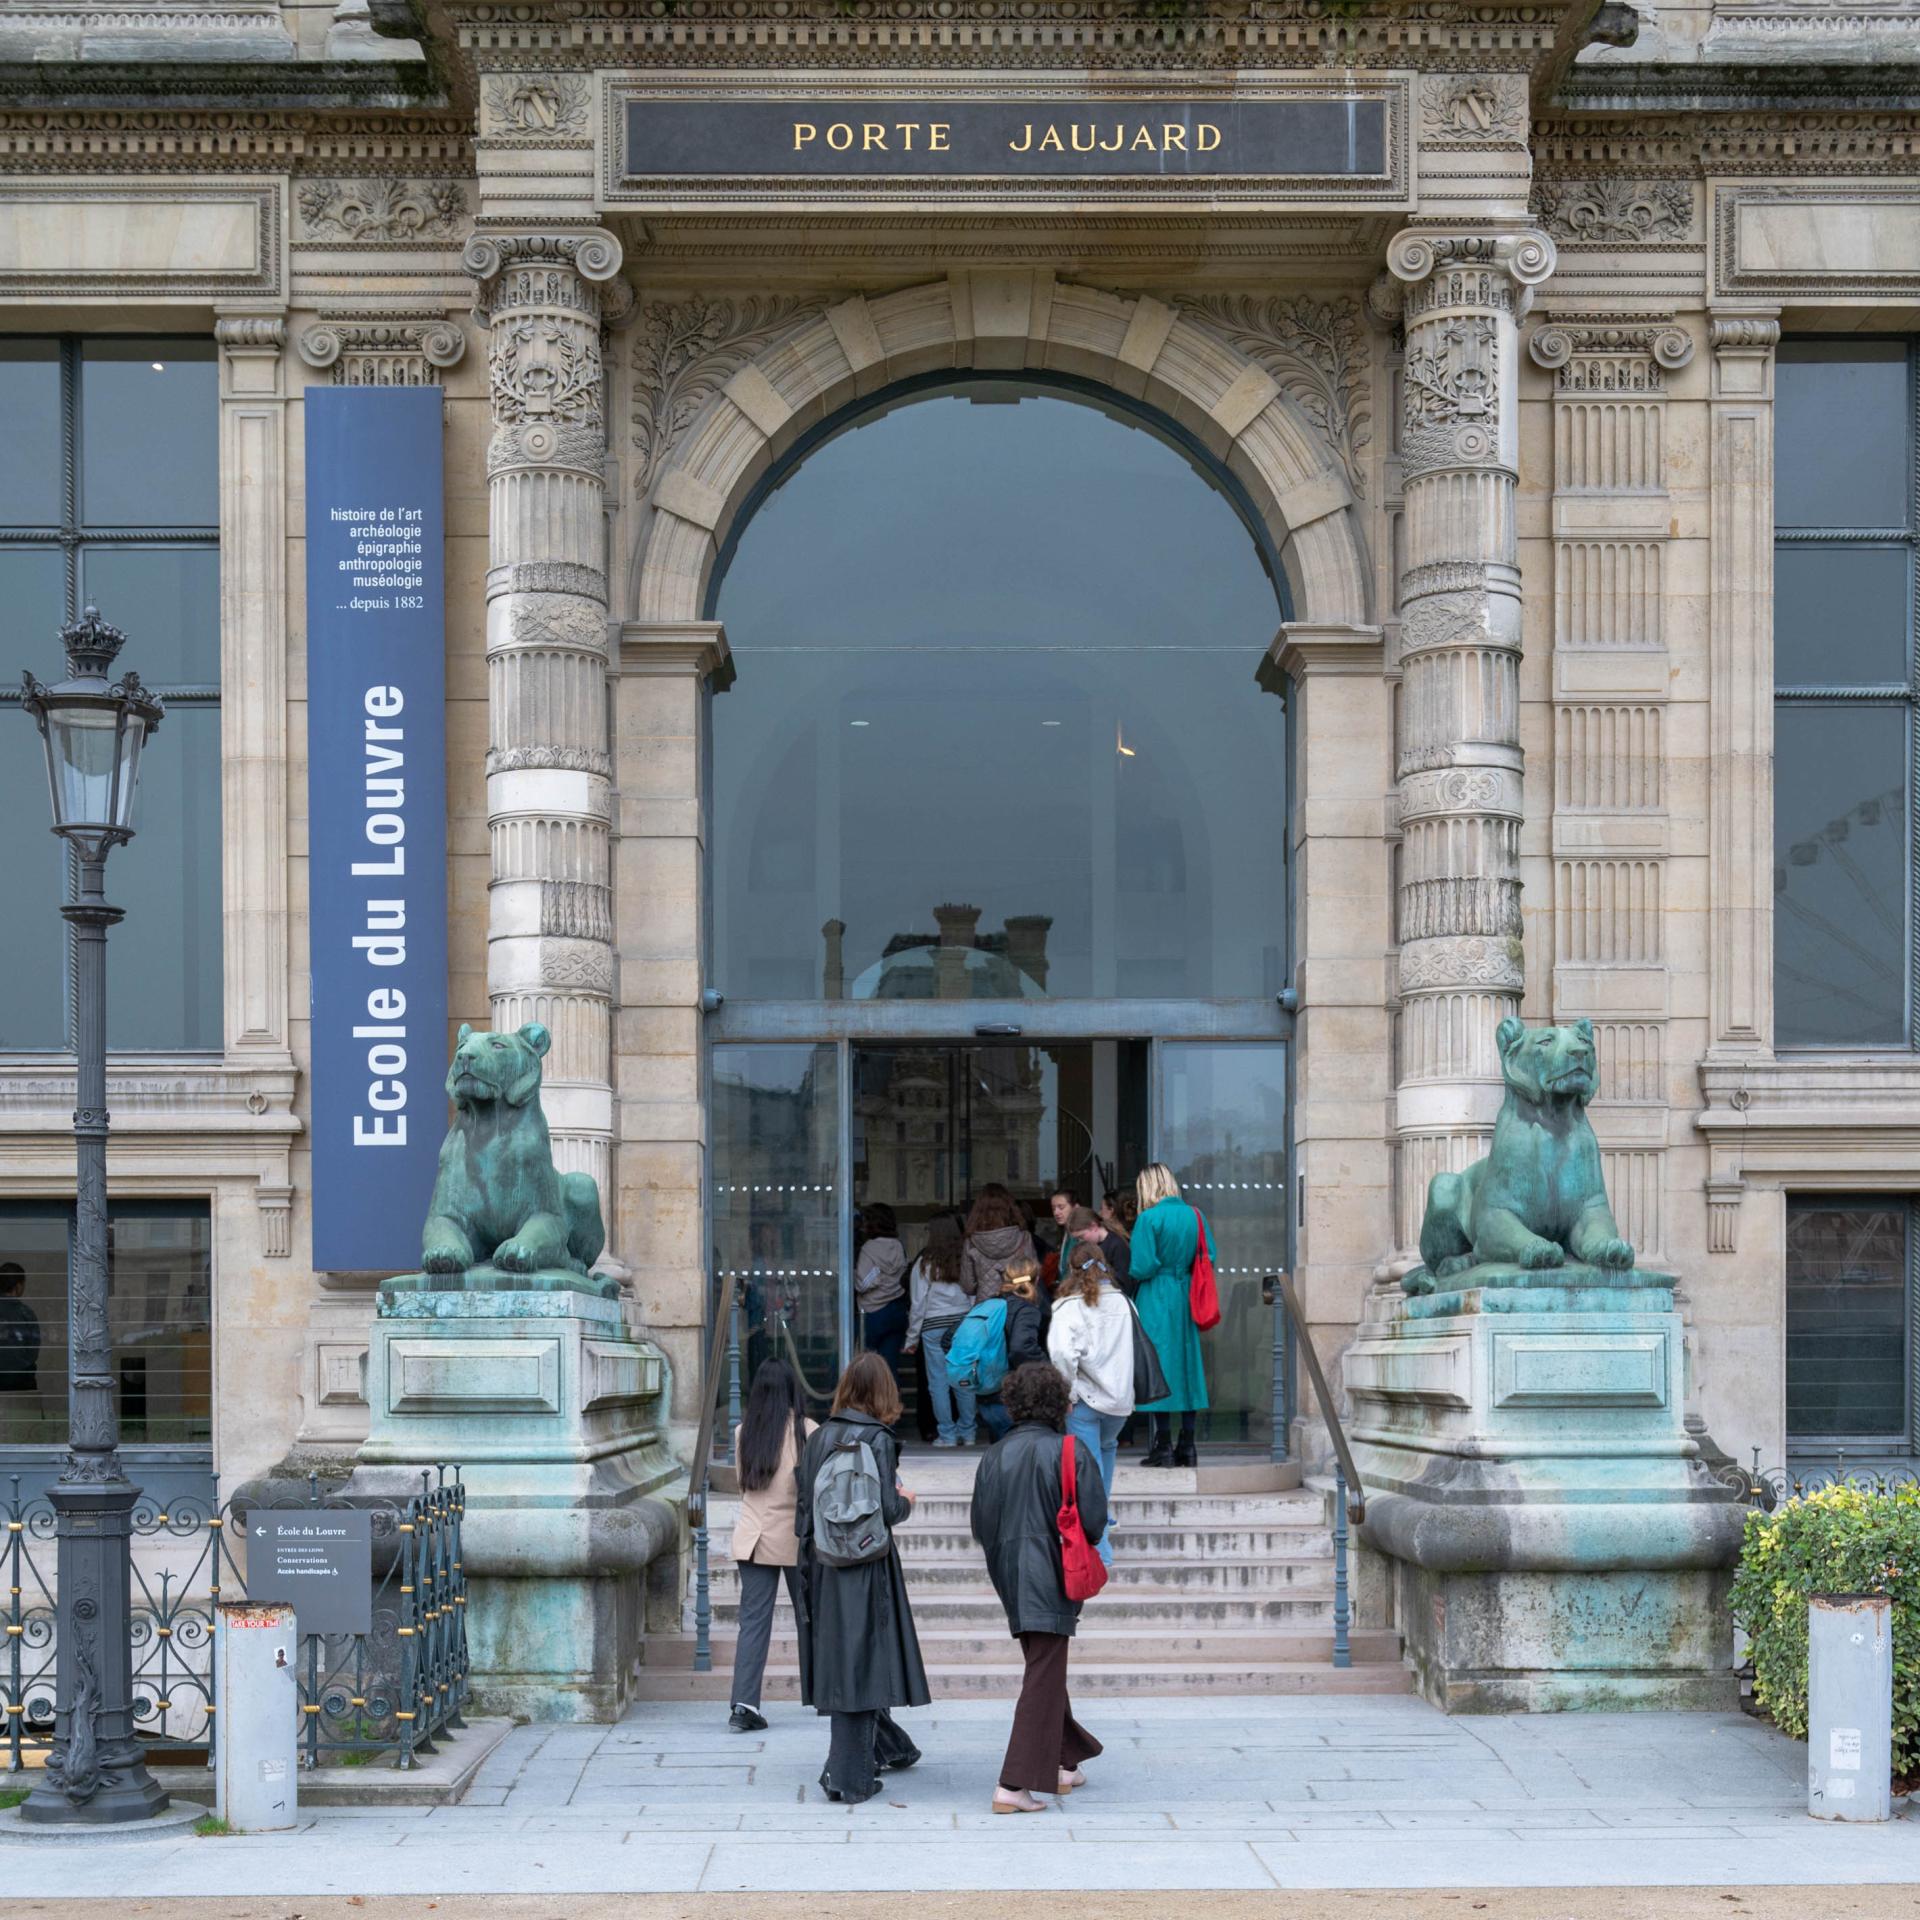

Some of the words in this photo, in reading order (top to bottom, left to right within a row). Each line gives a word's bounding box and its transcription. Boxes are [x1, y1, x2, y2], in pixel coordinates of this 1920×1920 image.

[792, 123, 951, 151] PORTE
[1009, 124, 1222, 151] JAUJARD
[330, 507, 376, 521] histoire
[380, 507, 395, 521] de
[398, 507, 423, 521] l'art
[350, 524, 422, 540] archéologie
[357, 540, 422, 556] épigraphie
[339, 557, 423, 573] anthropologie
[353, 573, 423, 589] muséologie
[350, 596, 390, 612] depuis
[394, 596, 424, 609] 1882
[351, 683, 405, 876] Louvre
[352, 900, 406, 966] du
[353, 988, 407, 1146] Ecole
[277, 1525, 301, 1536] École
[302, 1526, 314, 1536] du
[316, 1526, 347, 1536] Louvre
[277, 1556, 328, 1564] Conservations
[296, 1568, 331, 1576] handicapés
[247, 1620, 265, 1628] YOUR
